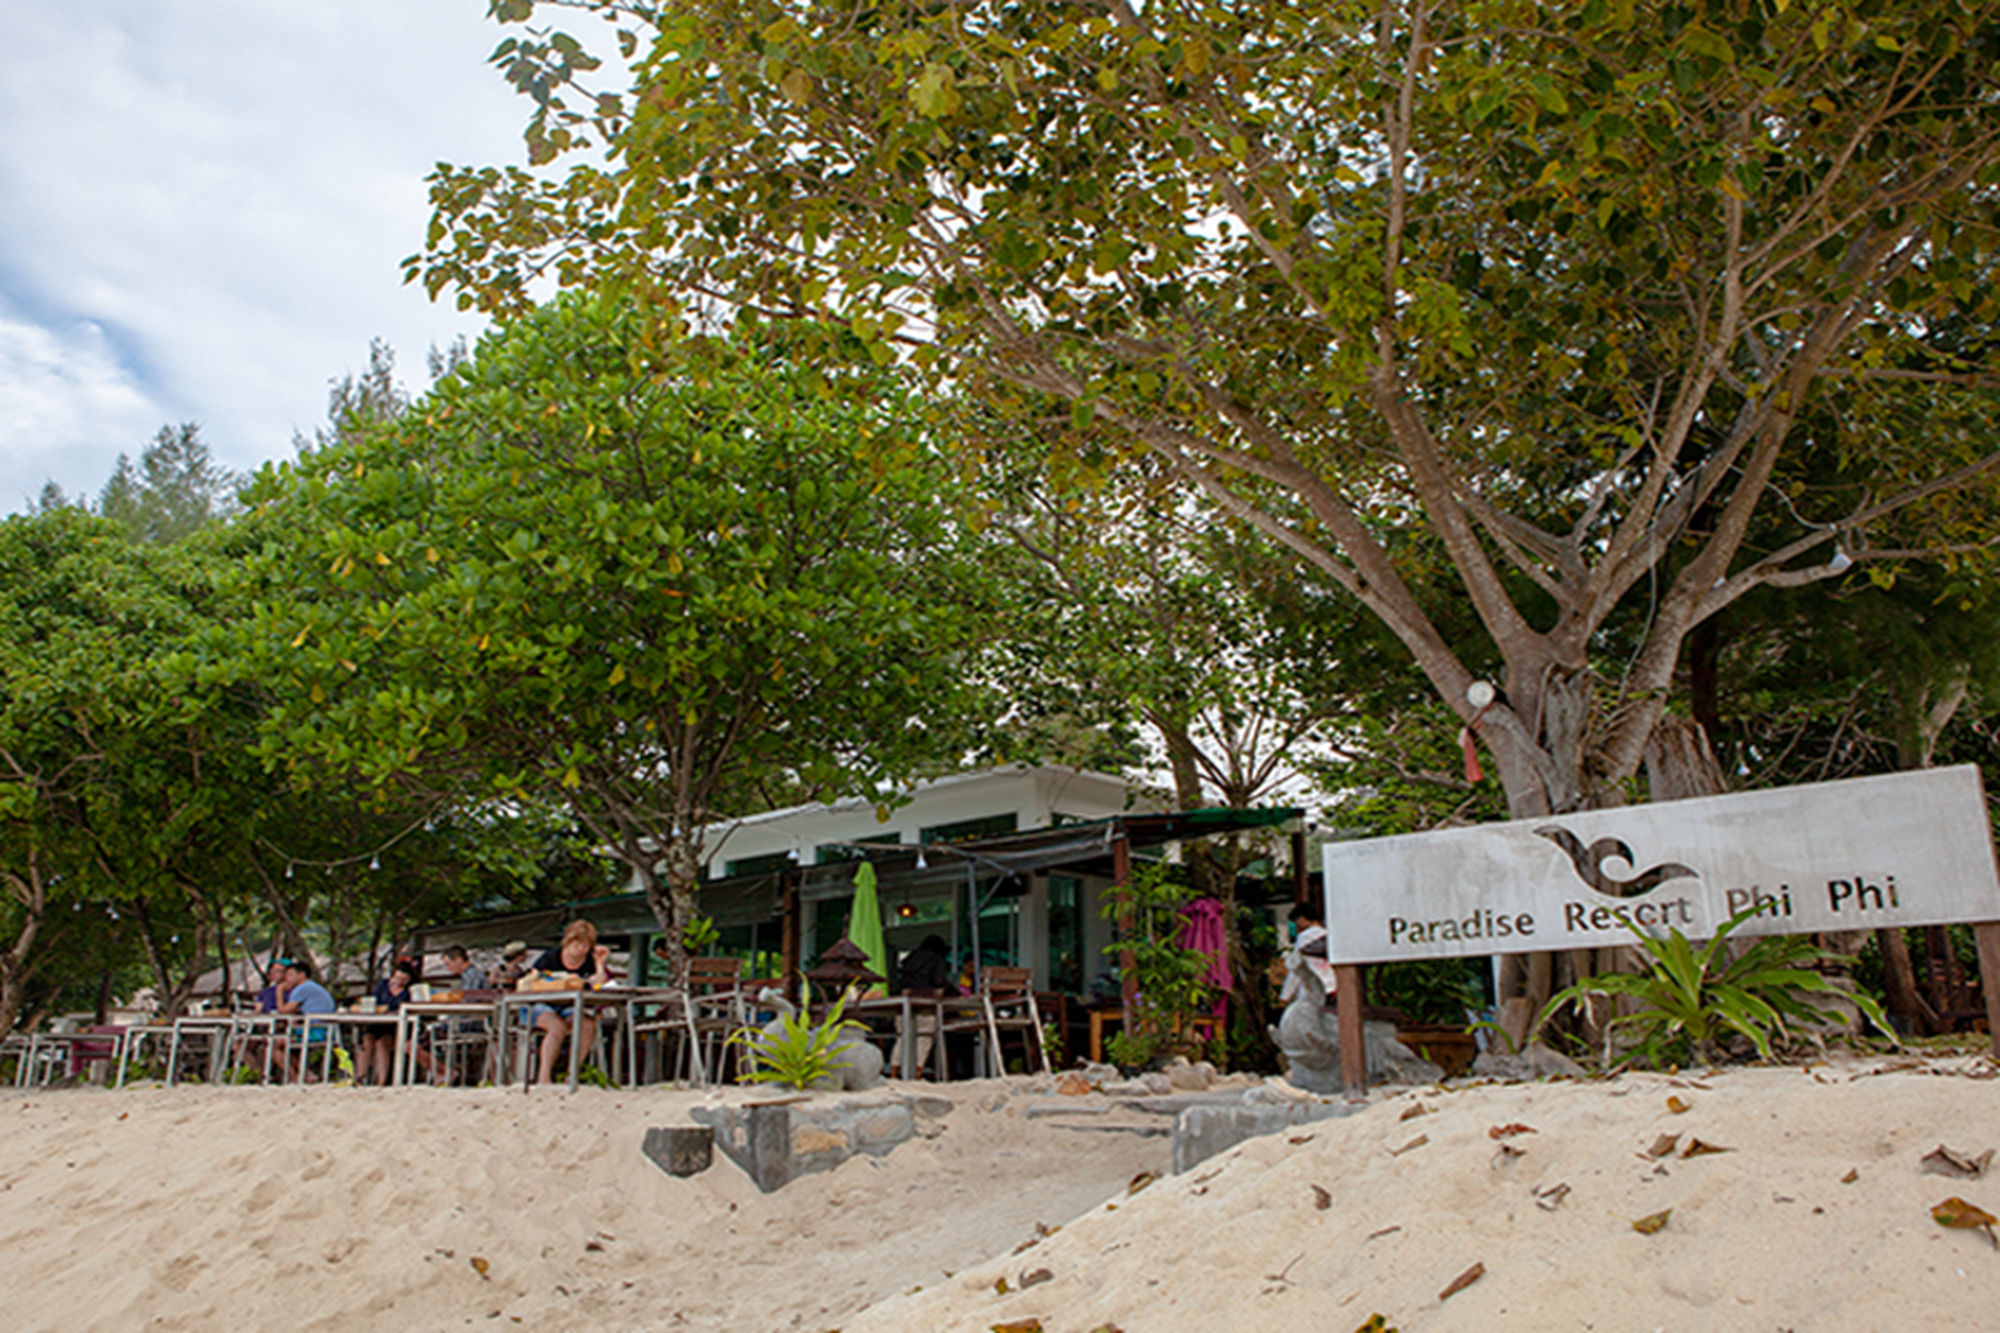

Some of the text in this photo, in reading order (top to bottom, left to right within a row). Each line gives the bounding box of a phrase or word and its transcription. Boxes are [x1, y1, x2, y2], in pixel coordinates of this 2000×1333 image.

[1389, 875, 1899, 944] Paradise Resort Phi Phi
